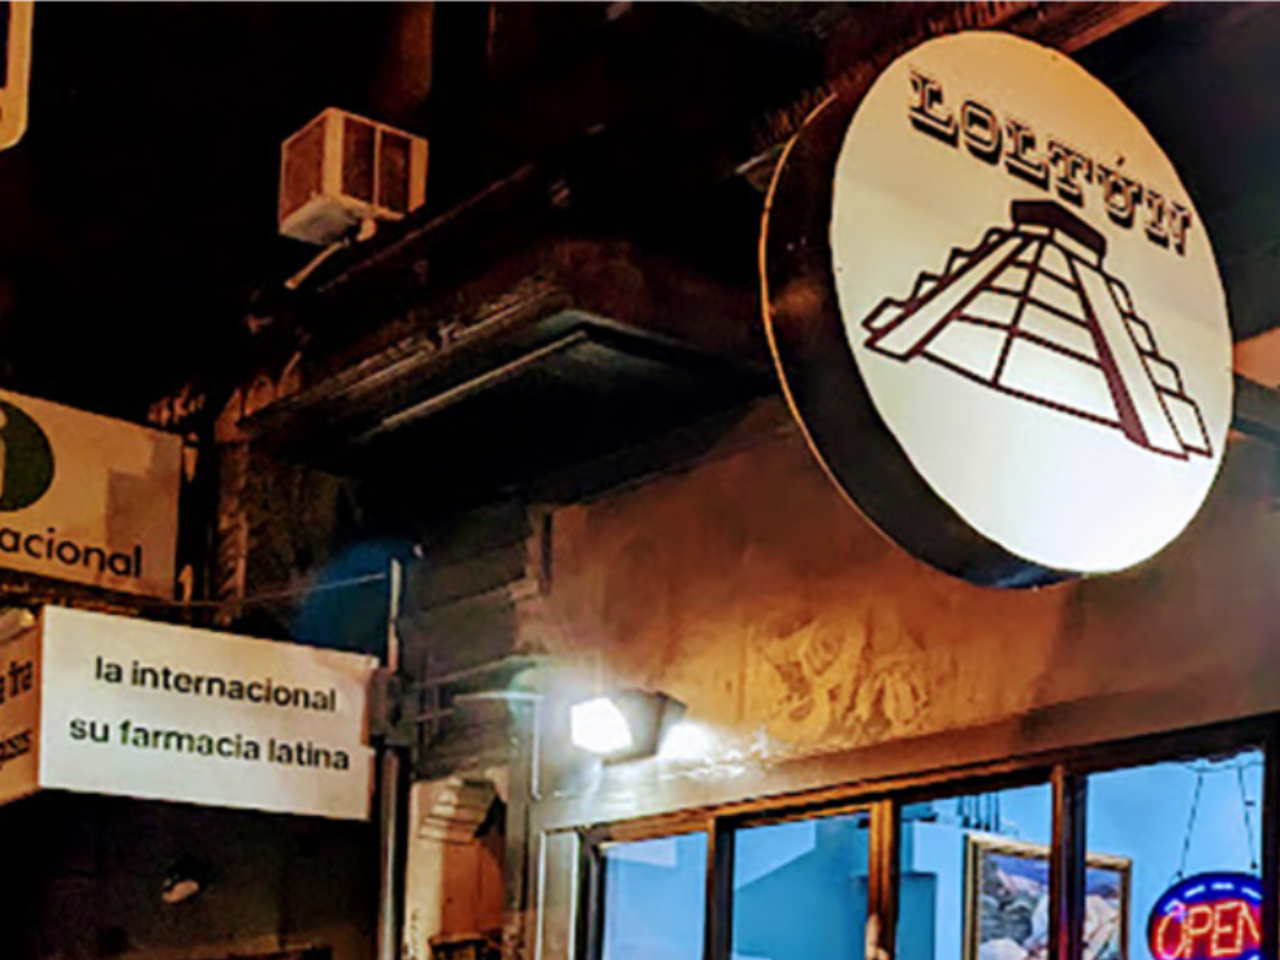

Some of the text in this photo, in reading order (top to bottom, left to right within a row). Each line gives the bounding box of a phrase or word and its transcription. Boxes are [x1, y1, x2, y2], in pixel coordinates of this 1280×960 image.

[95, 656, 336, 711] la internacional
[69, 717, 349, 771] su farmacia latina
